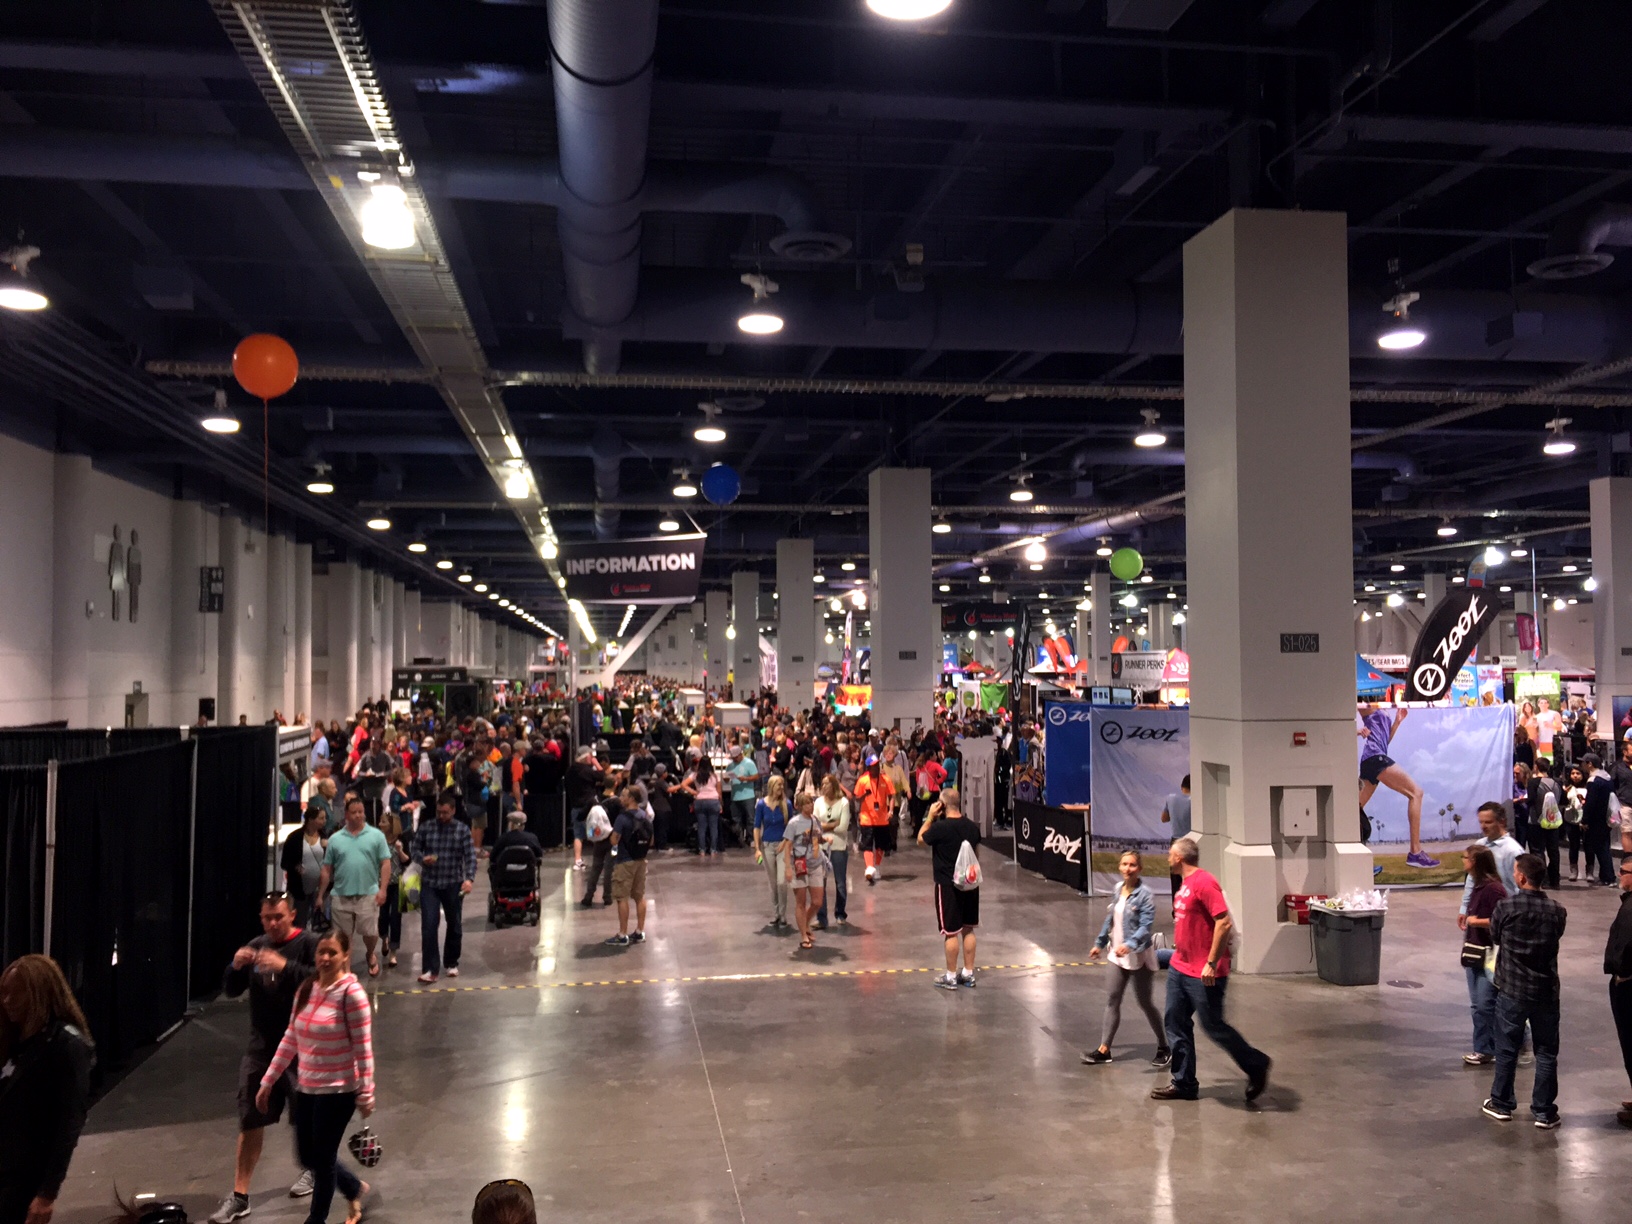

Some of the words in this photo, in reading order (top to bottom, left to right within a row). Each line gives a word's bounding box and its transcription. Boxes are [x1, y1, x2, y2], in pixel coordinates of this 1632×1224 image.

[566, 552, 696, 575] INFORMATION
[1283, 635, 1318, 652] S1-025
[1124, 660, 1146, 670] RUNNER
[1147, 659, 1165, 670] PERKS
